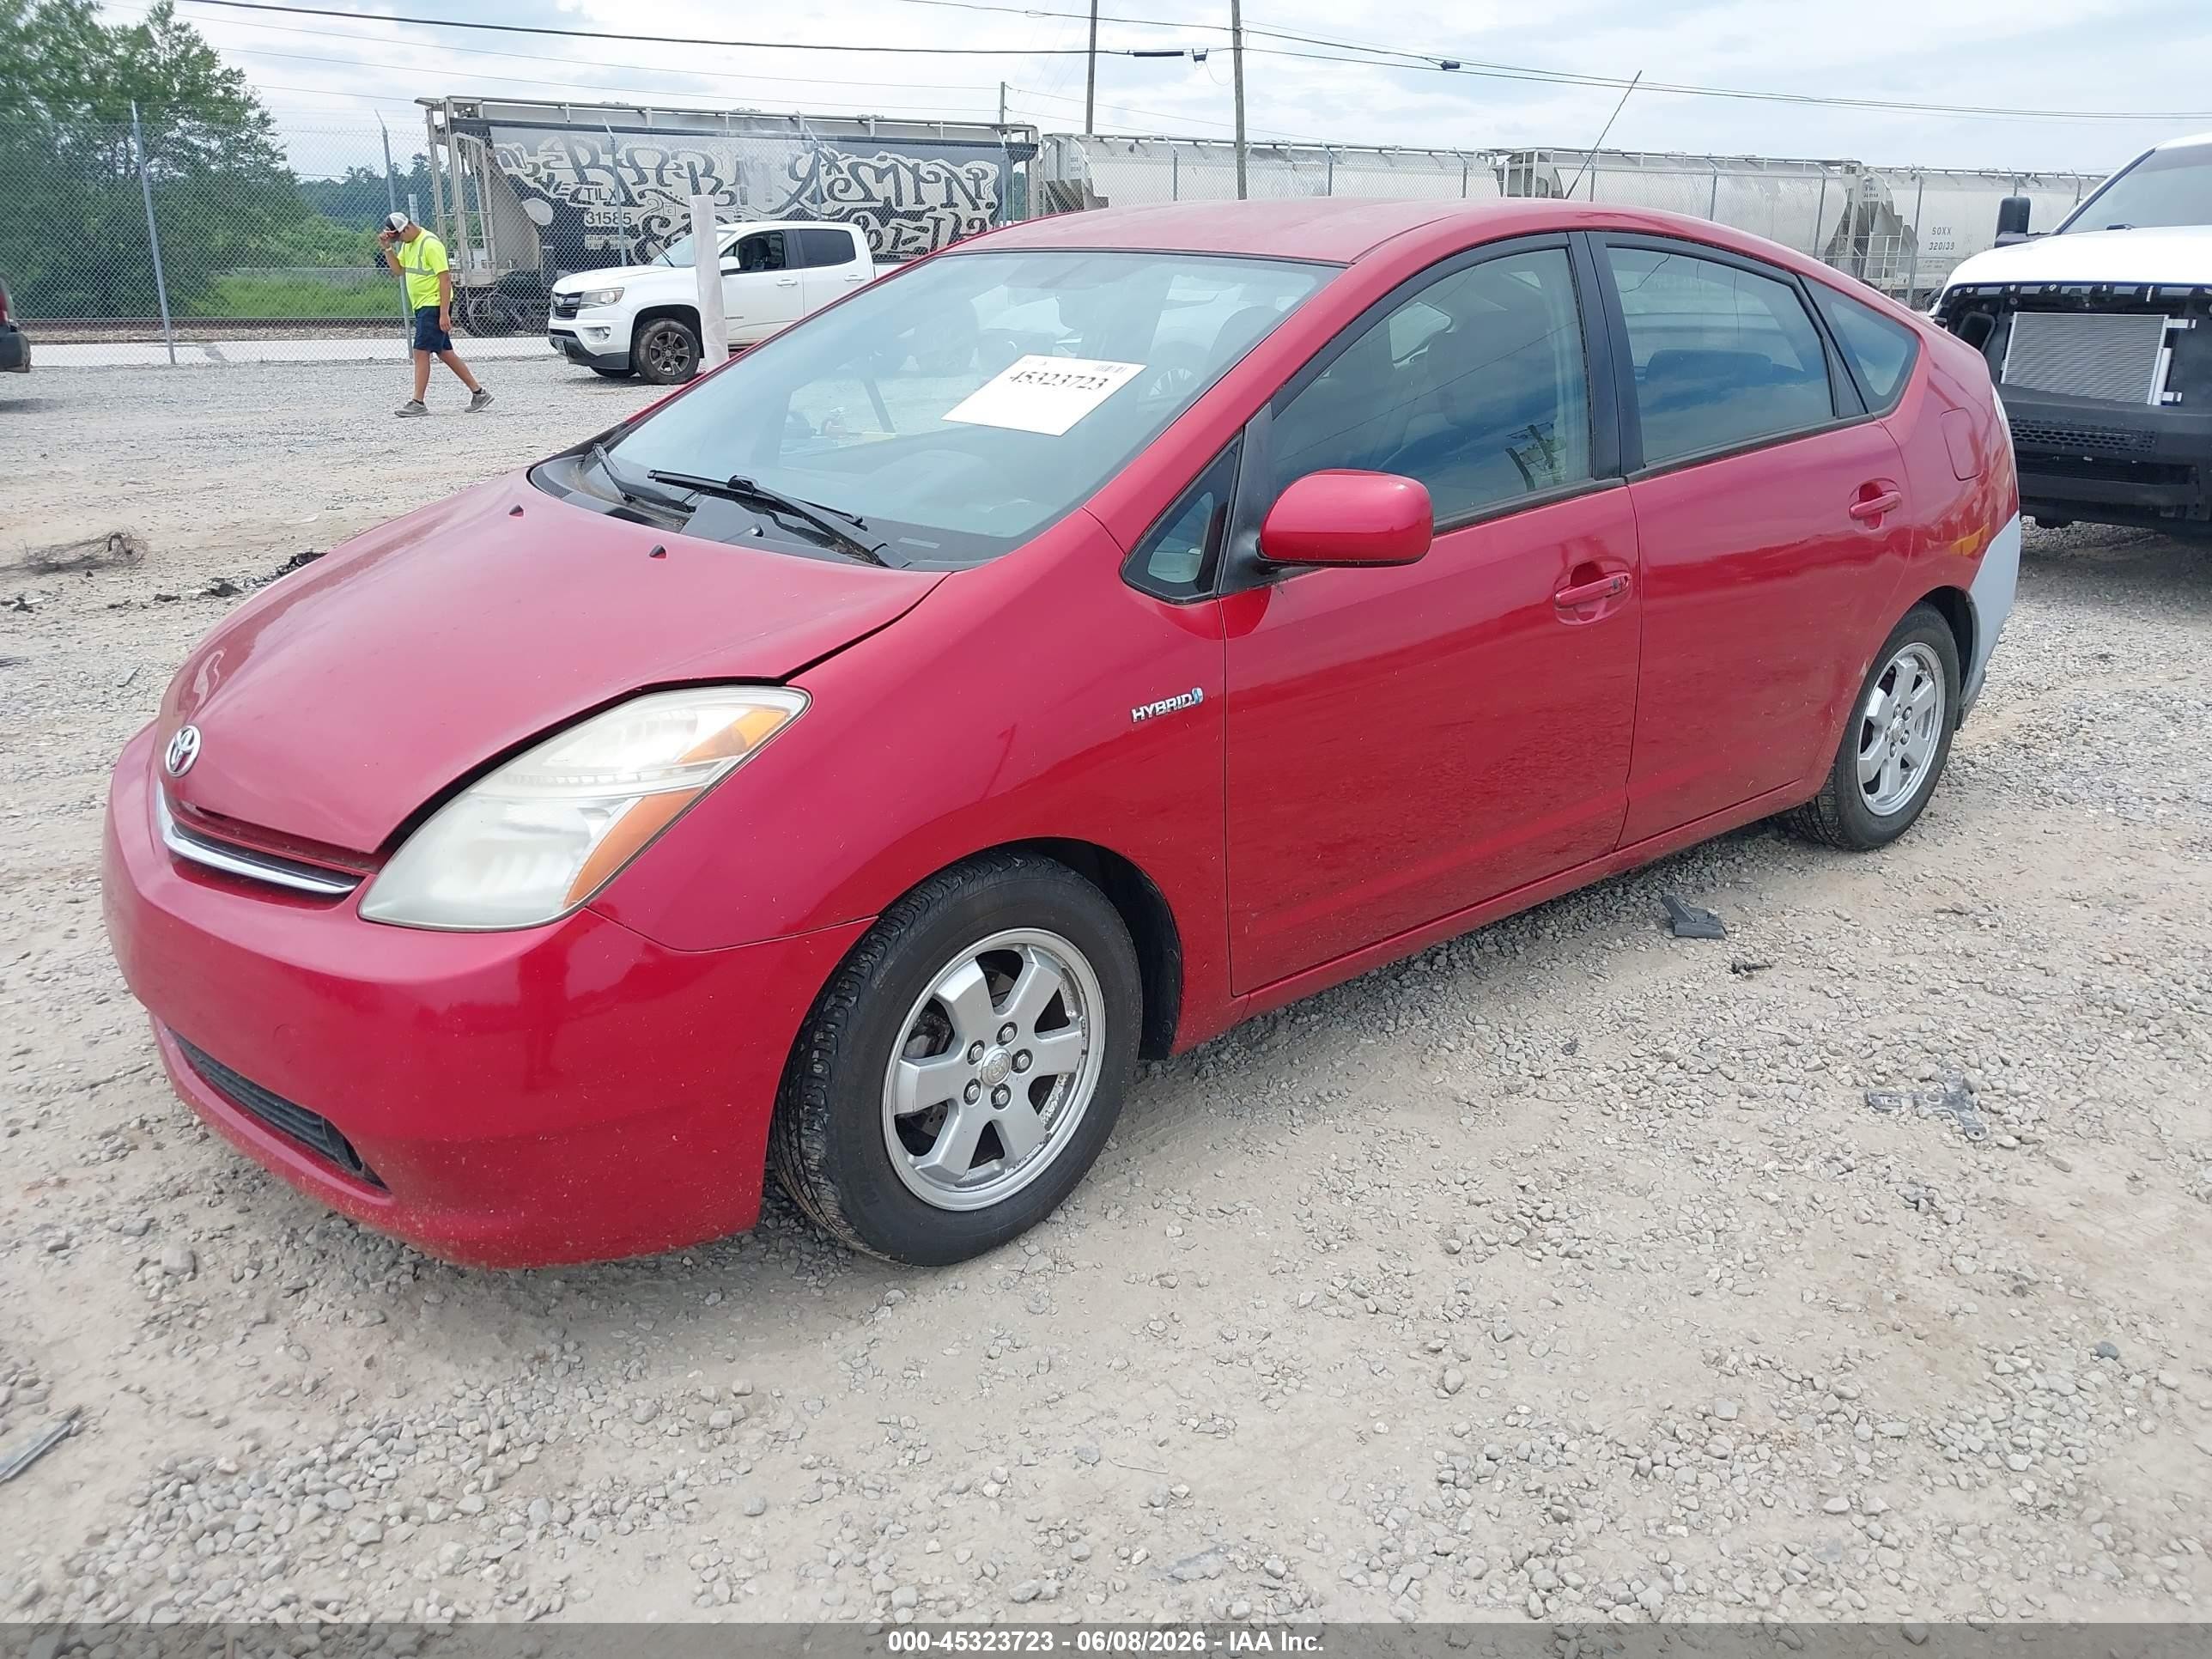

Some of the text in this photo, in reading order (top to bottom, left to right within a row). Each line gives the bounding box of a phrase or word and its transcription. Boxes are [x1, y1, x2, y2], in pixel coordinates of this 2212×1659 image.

[583, 187, 617, 201] TILX
[586, 211, 632, 225] 31585
[1931, 227, 1952, 235] SOXX
[1929, 241, 1955, 251] 320139
[1010, 371, 1109, 390] 45323723
[1132, 692, 1196, 722] HYBRID
